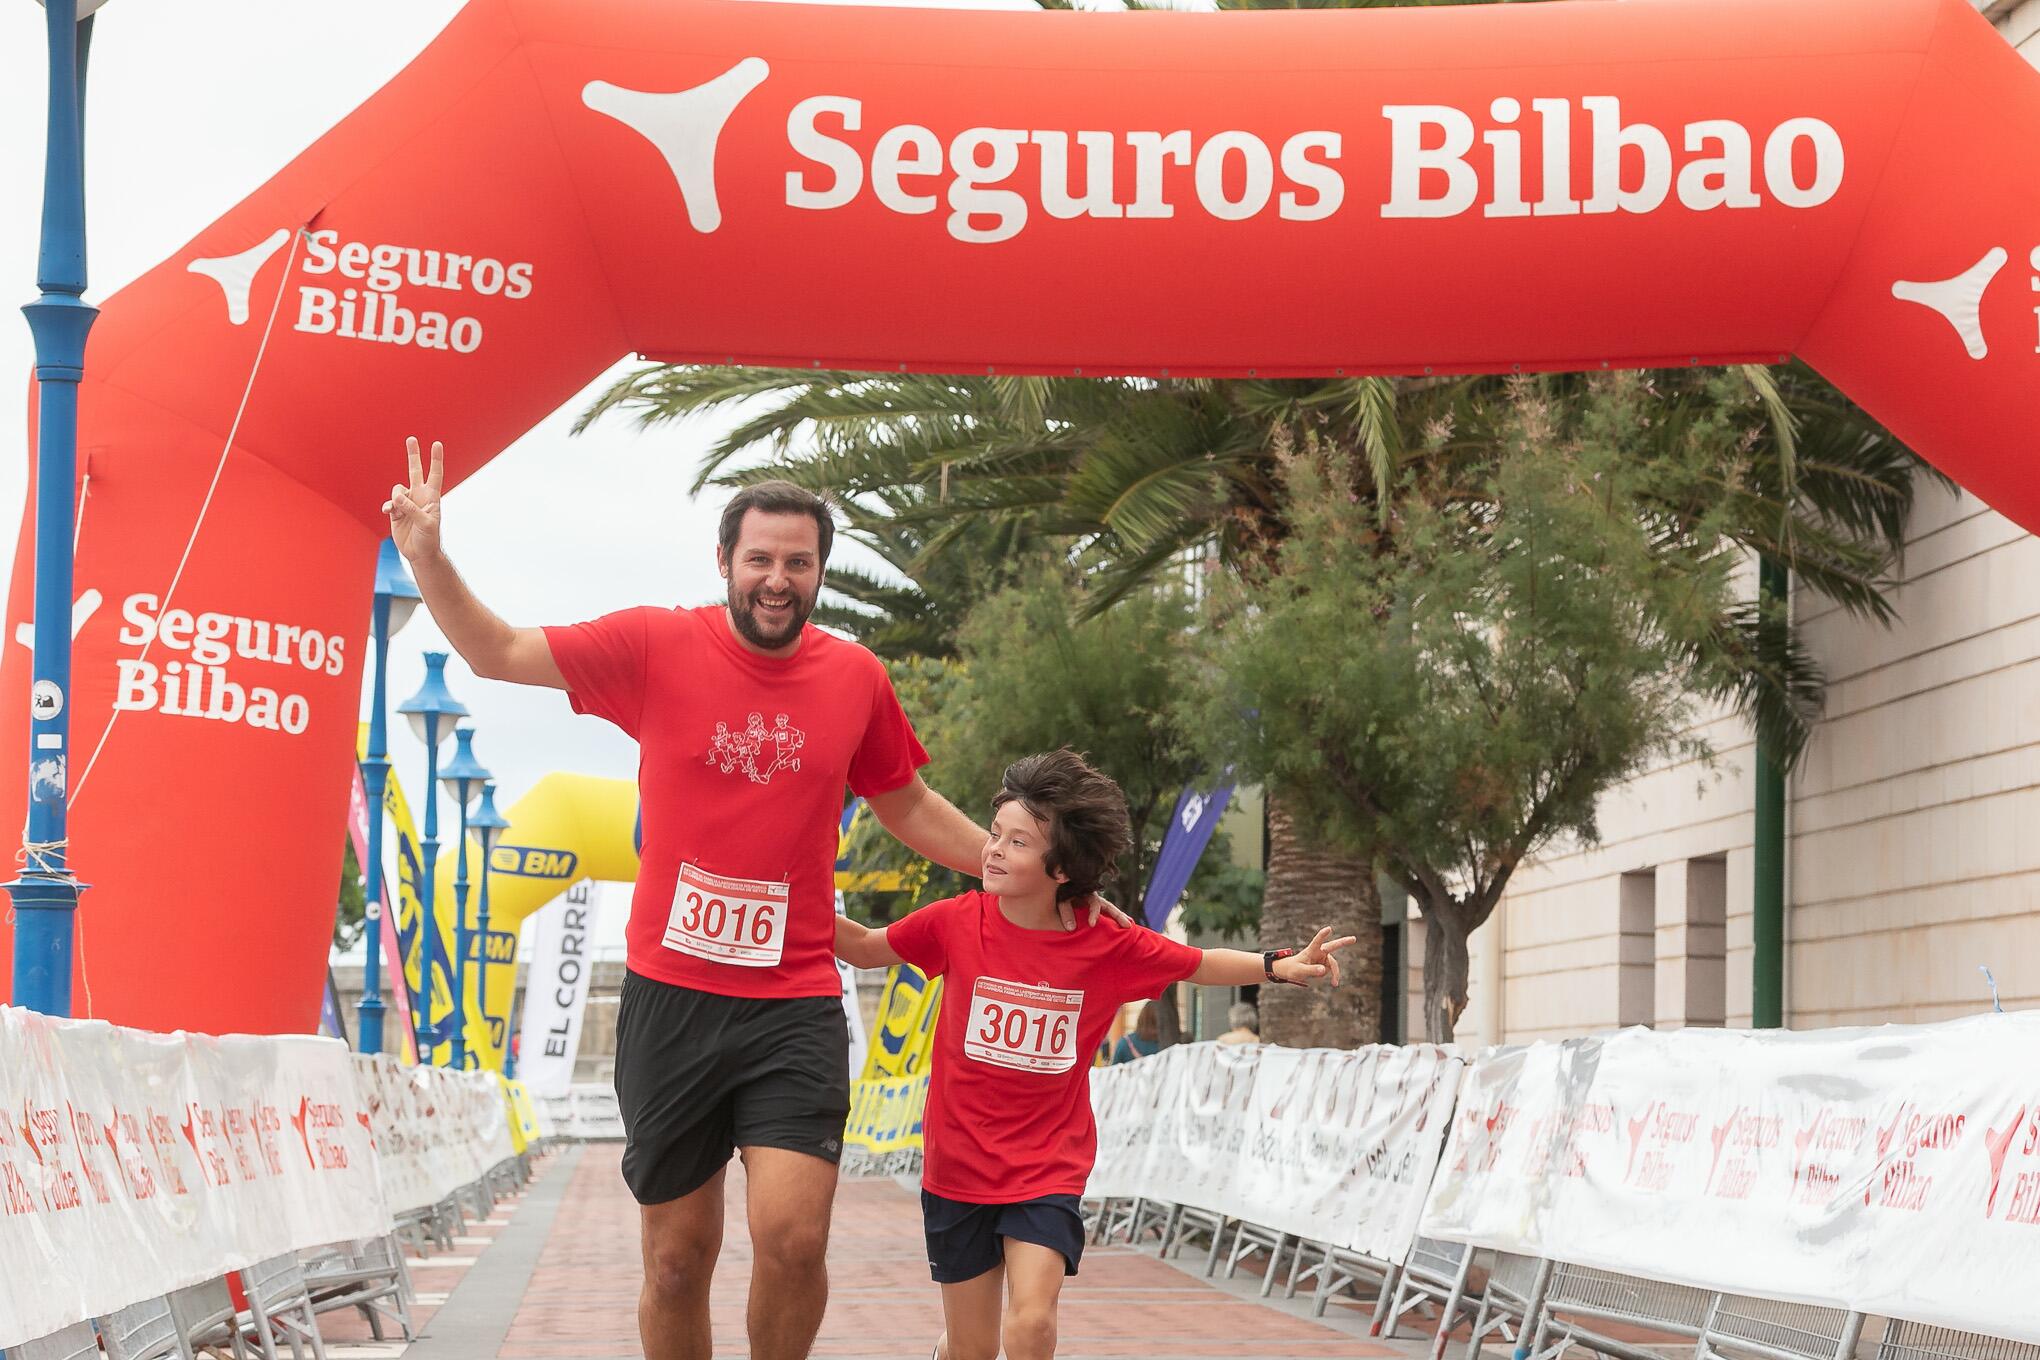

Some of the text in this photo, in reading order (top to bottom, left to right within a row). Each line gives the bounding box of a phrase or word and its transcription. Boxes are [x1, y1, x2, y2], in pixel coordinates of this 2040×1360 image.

[785, 95, 1845, 243] Seguros Bilbao
[302, 229, 534, 299] Seguros
[294, 286, 483, 354] Bilbao
[118, 593, 345, 676] Seguros
[112, 658, 310, 735] Bilbao
[523, 851, 573, 877] BM
[681, 891, 776, 946] 3016
[544, 1017, 570, 1058] EL
[979, 1003, 1070, 1055] 3016
